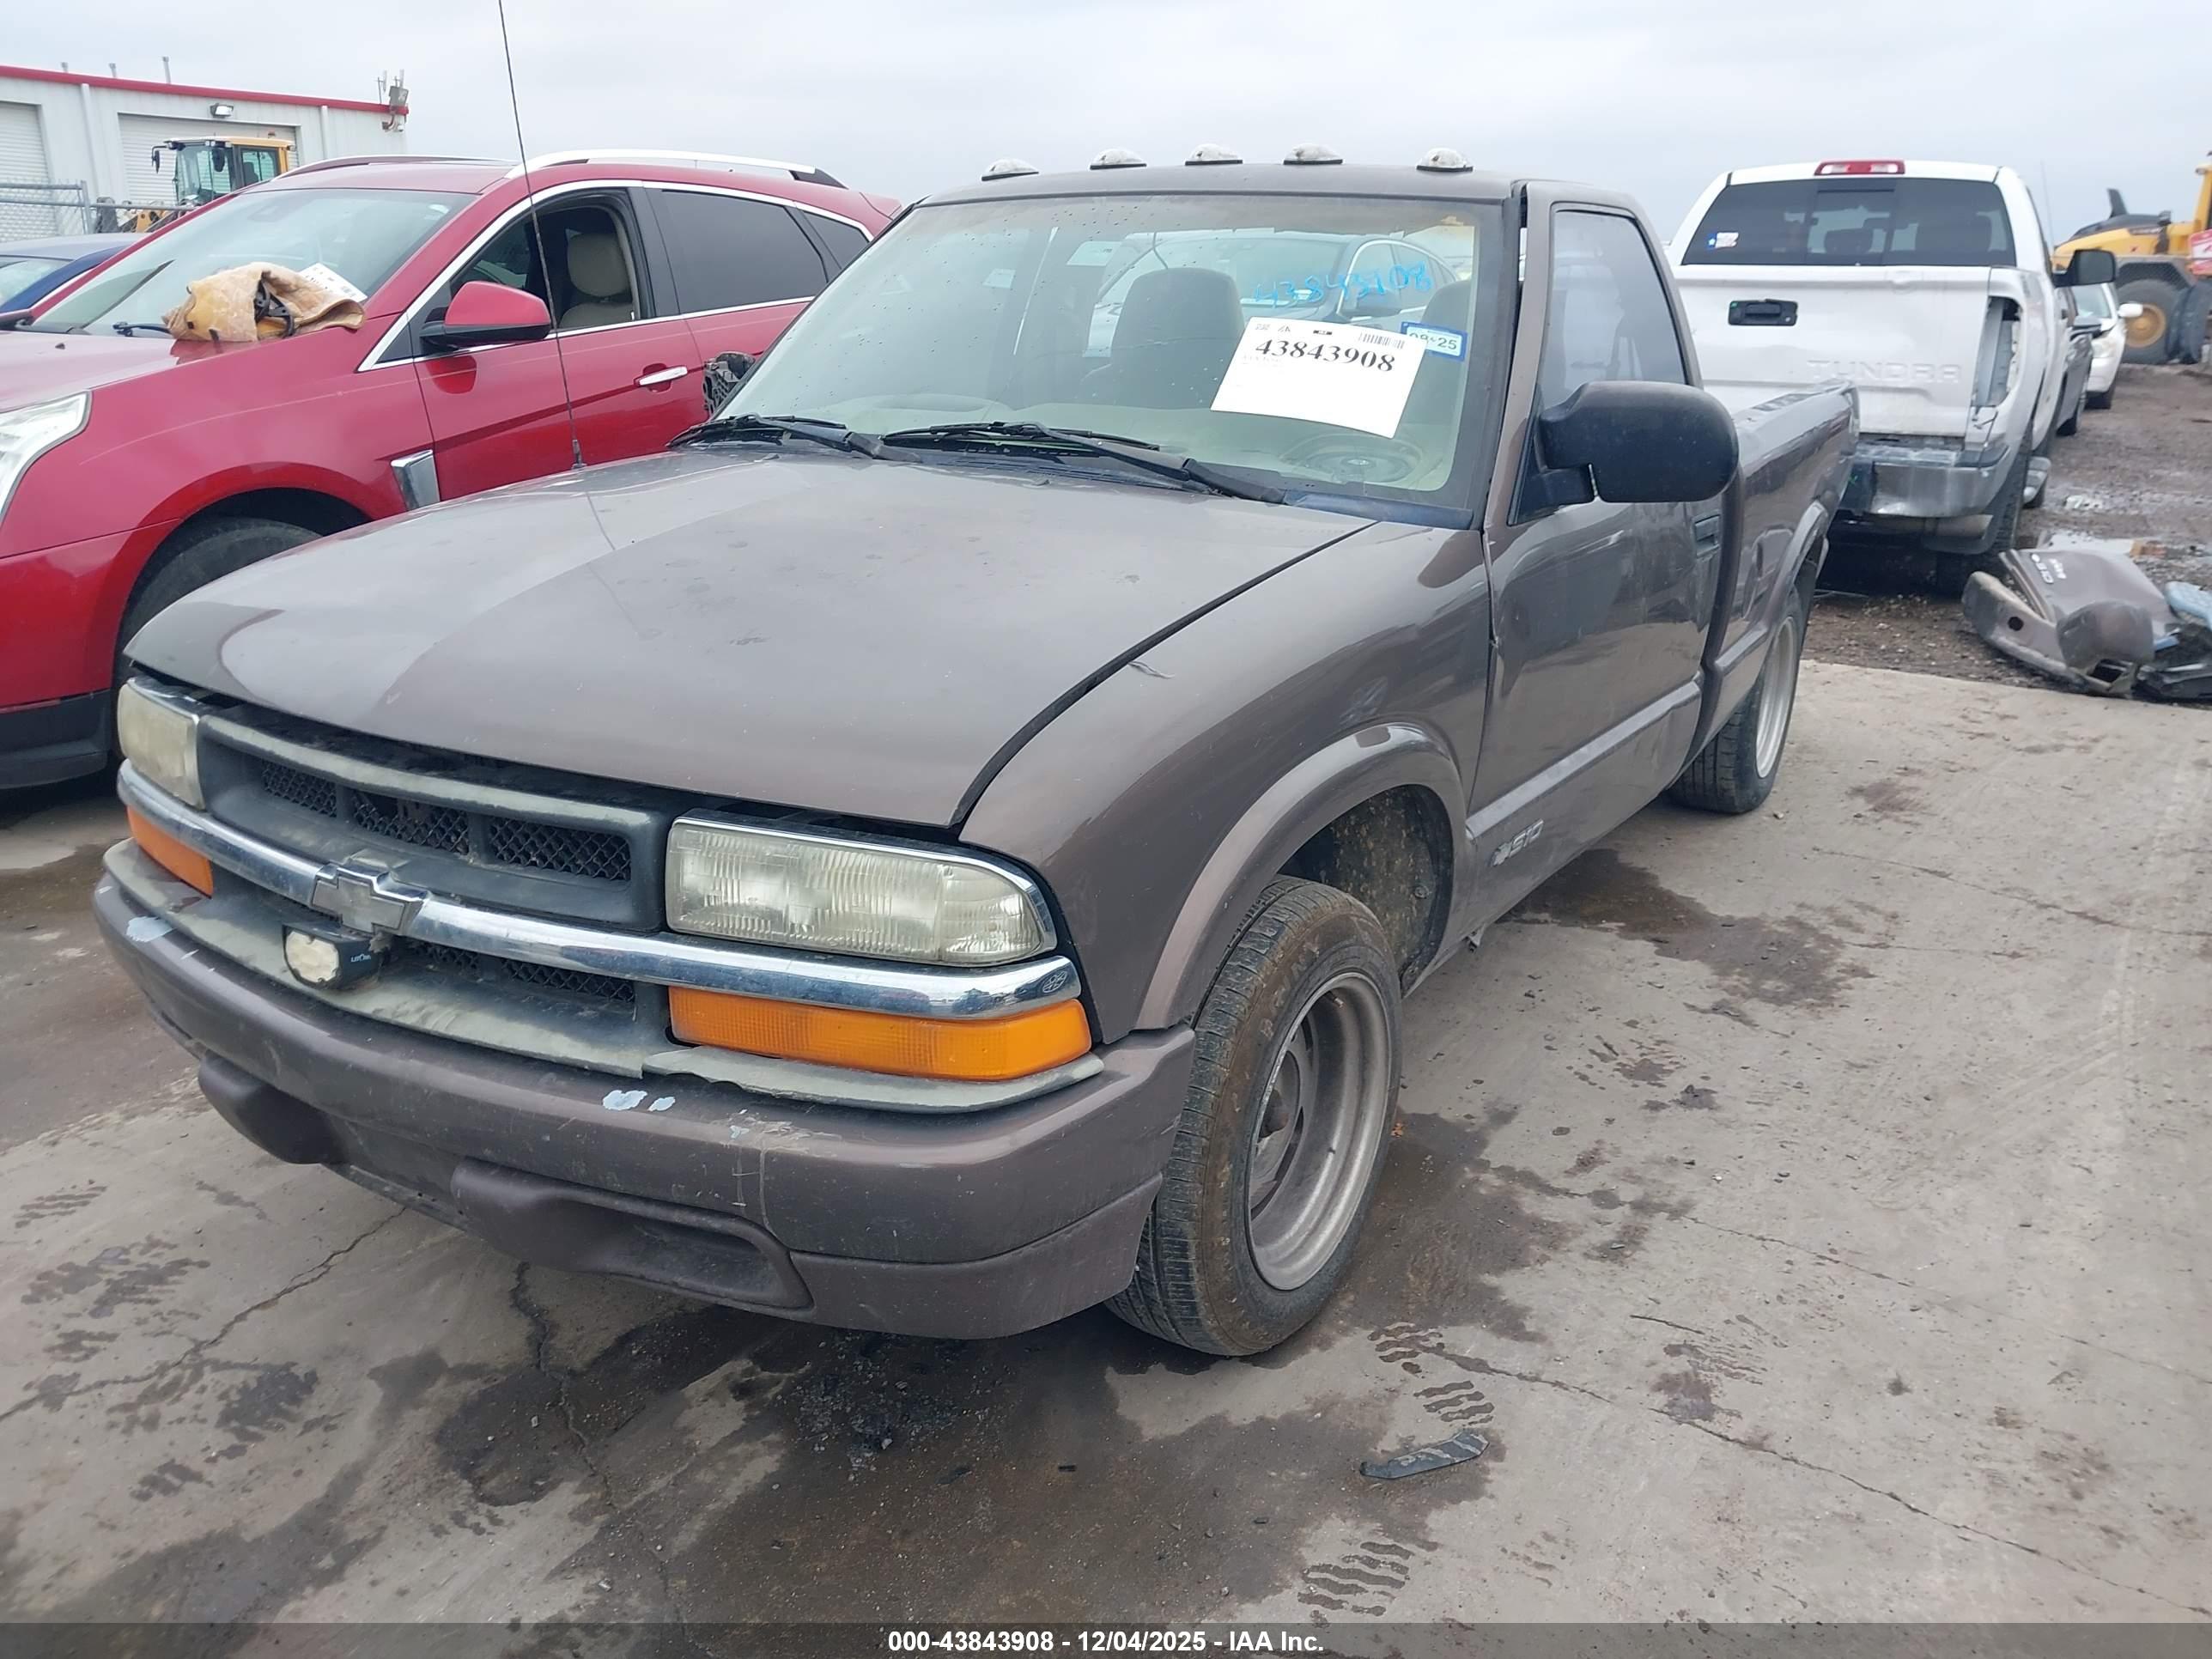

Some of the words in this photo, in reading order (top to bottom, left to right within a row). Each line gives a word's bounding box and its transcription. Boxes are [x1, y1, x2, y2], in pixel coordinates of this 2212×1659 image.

[1437, 337, 1457, 349] 25
[1255, 339, 1395, 372] 43843908
[1807, 359, 1962, 383] TUNDRA
